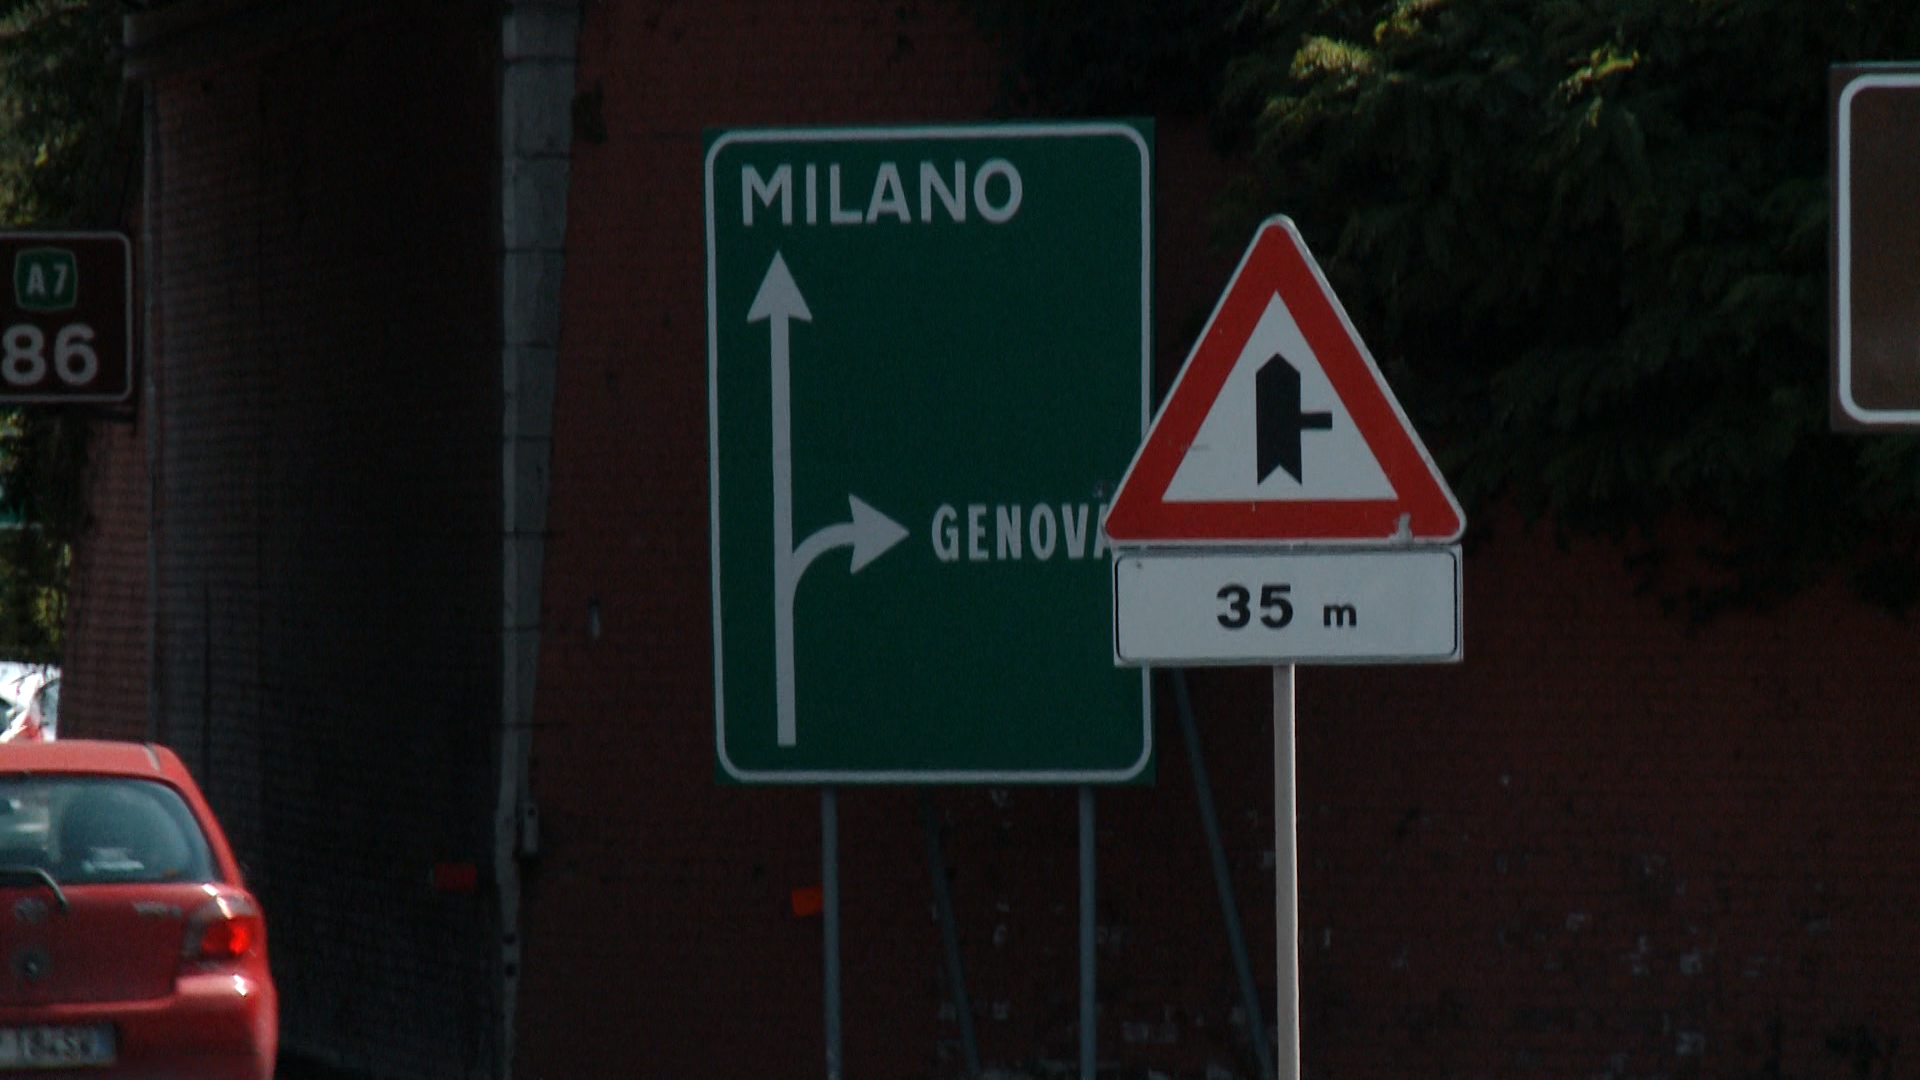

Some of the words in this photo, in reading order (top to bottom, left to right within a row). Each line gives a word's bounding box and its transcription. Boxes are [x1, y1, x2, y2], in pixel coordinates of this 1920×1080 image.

[741, 157, 1024, 226] MILANO
[25, 262, 69, 297] A7
[1, 322, 98, 386] 86
[1216, 584, 1293, 628] 35
[1323, 603, 1357, 627] m
